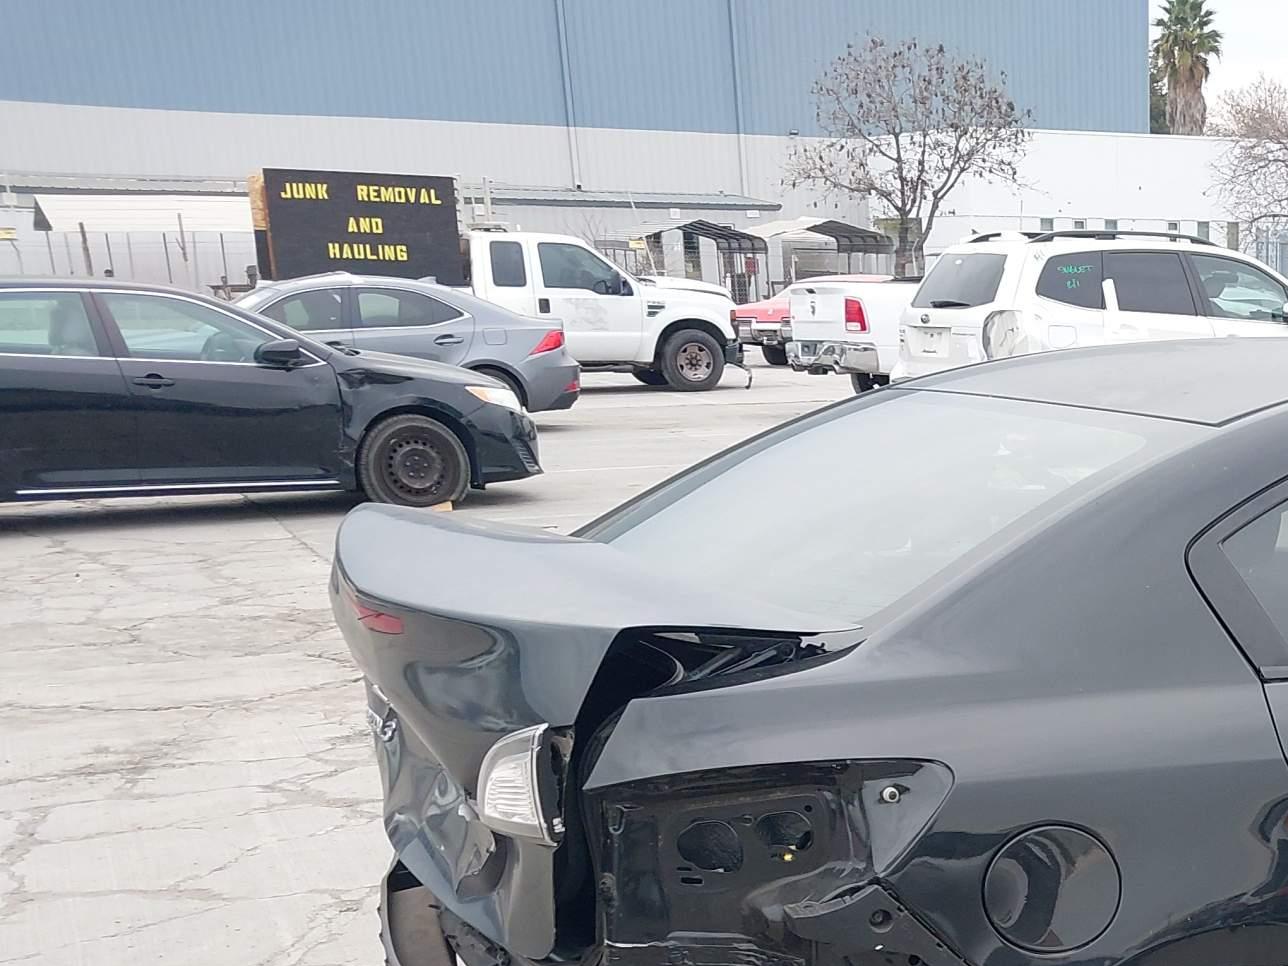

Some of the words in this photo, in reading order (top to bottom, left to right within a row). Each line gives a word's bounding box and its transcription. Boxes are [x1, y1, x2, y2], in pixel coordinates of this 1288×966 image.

[280, 182, 329, 200] JUNK
[356, 184, 442, 205] REMOVAL
[347, 216, 384, 234] AND
[327, 242, 408, 261] HAULING
